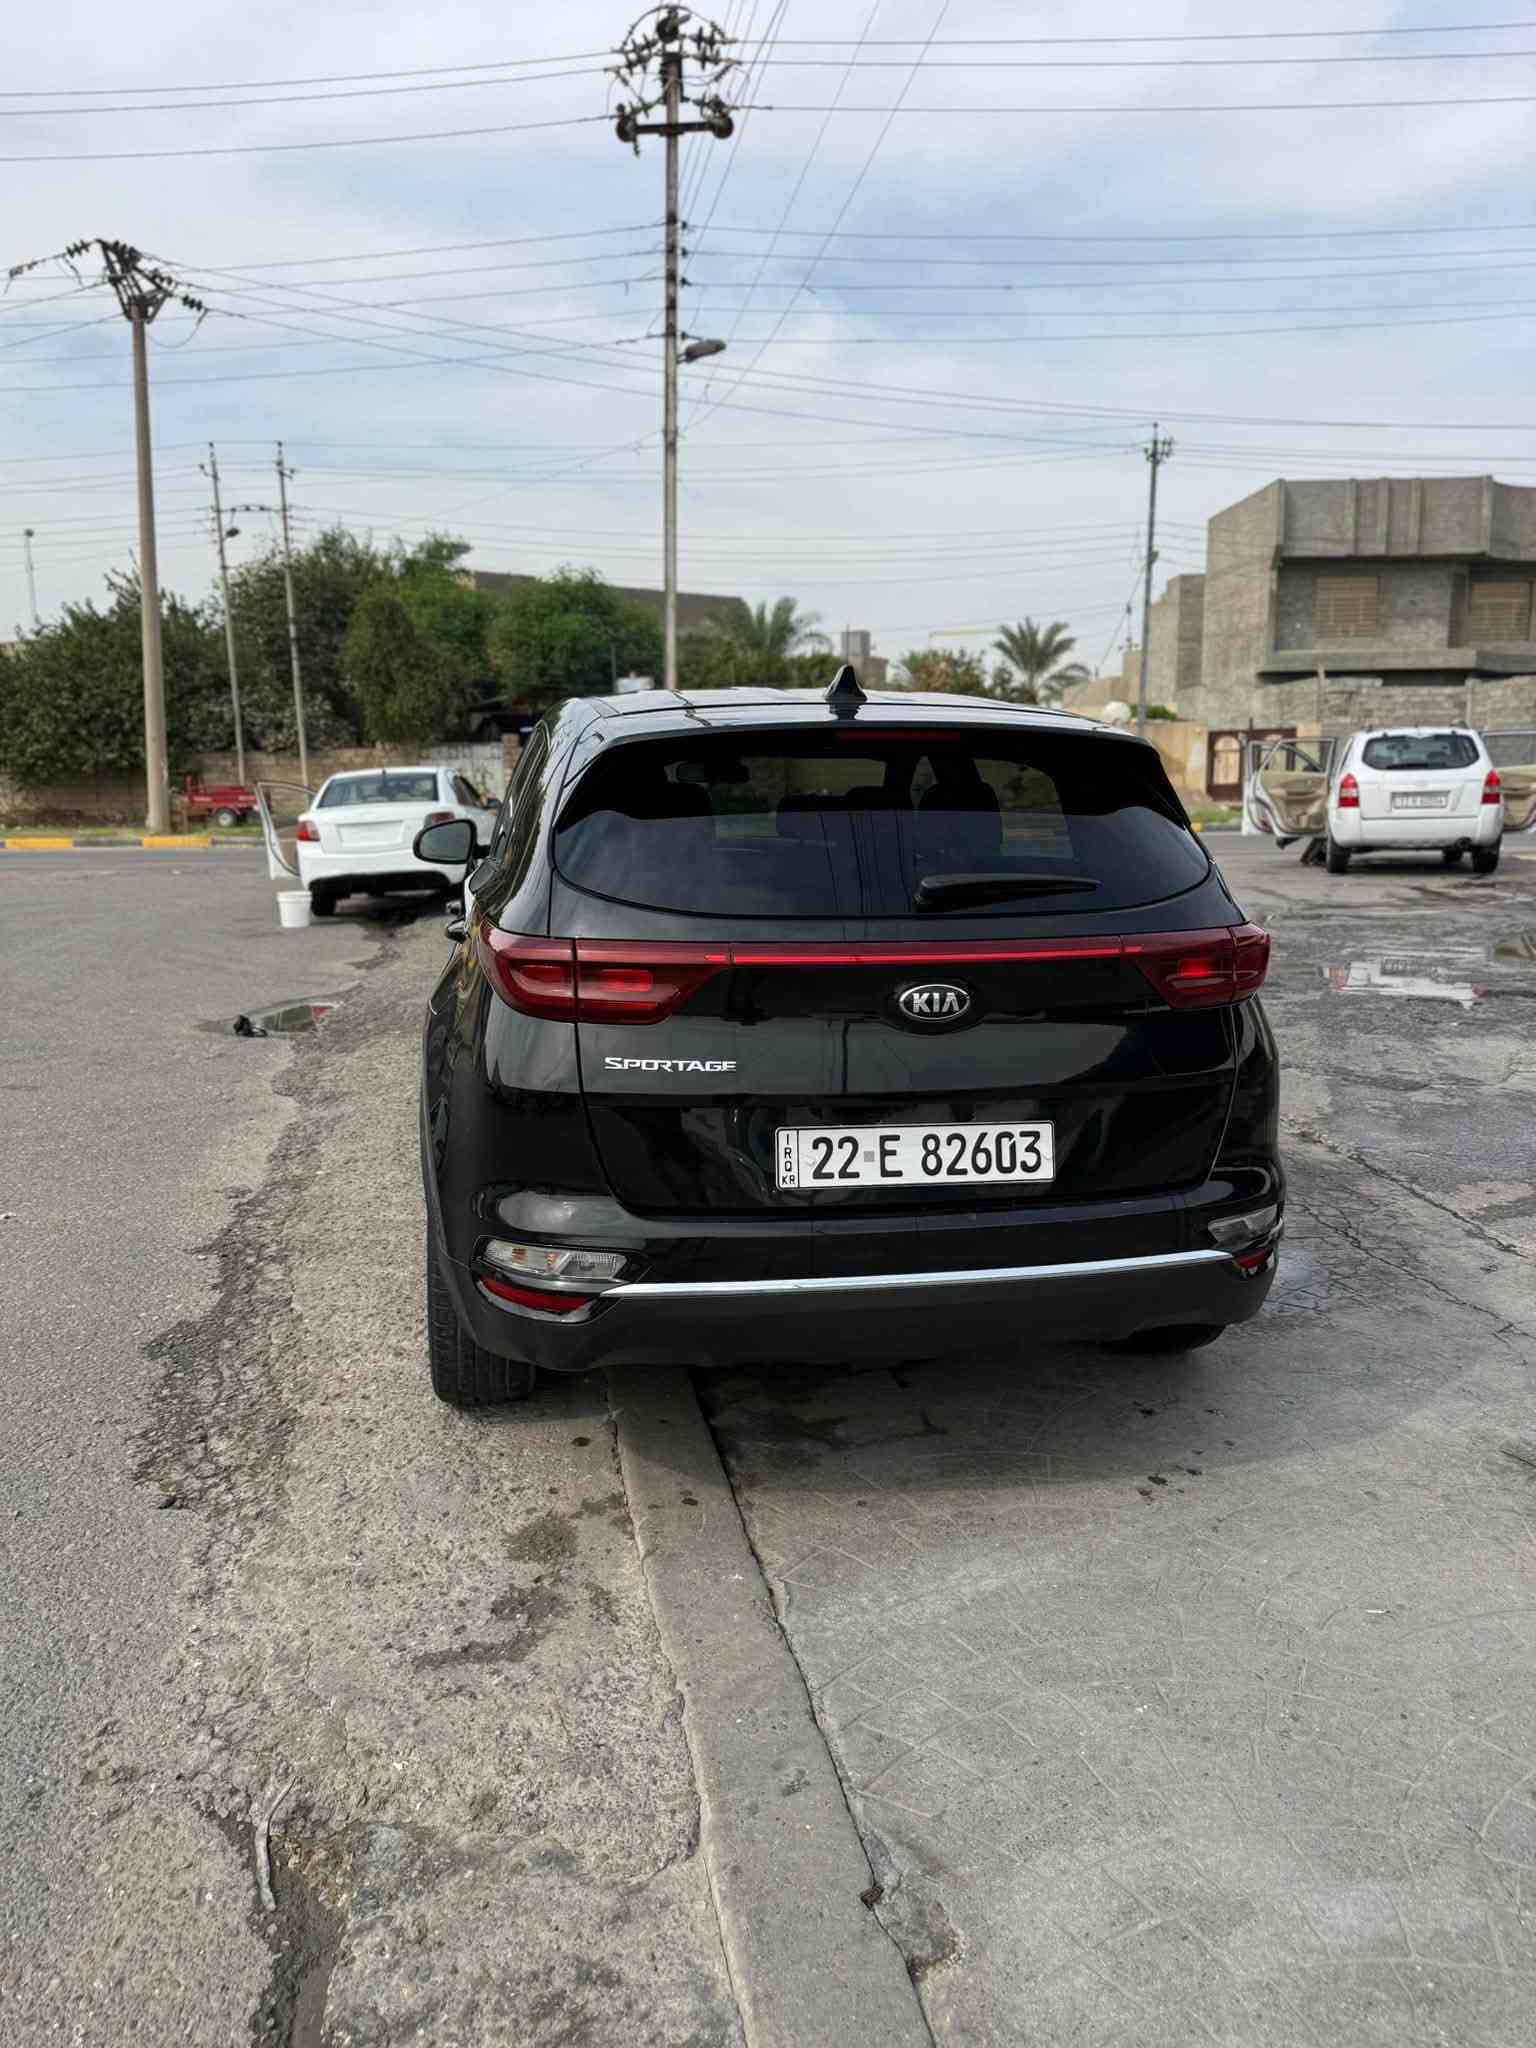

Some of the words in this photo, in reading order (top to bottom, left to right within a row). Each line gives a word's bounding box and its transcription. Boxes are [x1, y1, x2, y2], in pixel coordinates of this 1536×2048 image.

[912, 991, 960, 1013] KIA
[604, 1057, 737, 1073] SPORTAGE
[812, 1136, 861, 1180] 22
[880, 1134, 904, 1178] E
[920, 1130, 1042, 1177] 82603
